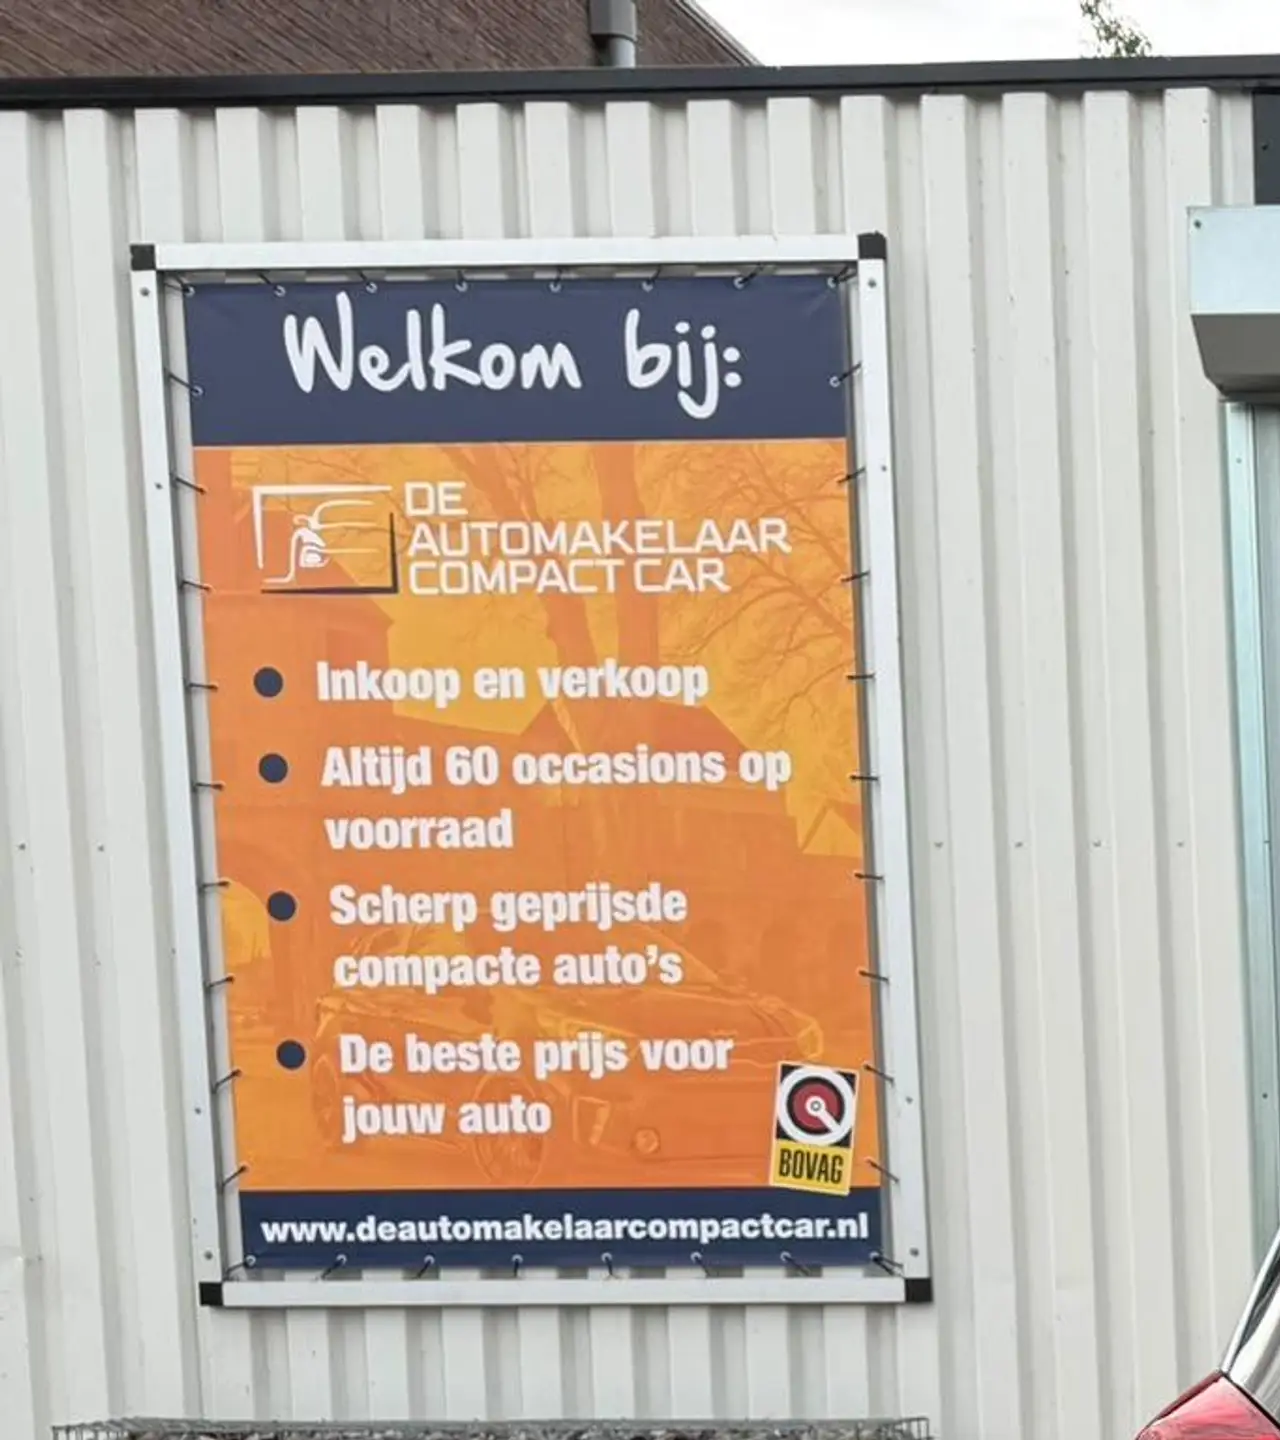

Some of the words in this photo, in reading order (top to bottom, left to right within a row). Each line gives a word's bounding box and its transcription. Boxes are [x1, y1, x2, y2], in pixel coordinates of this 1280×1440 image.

[283, 292, 582, 393] Welkom
[623, 309, 743, 418] bij:
[405, 481, 467, 517] DE
[408, 517, 792, 556] AUTOMAKELAAR
[410, 558, 625, 595] COMPACT
[634, 557, 732, 592] CAR
[316, 661, 460, 708] Inkoop
[474, 666, 525, 699] en
[538, 658, 709, 705] verkoop
[321, 746, 432, 794] Altijd
[445, 746, 499, 786] 60
[512, 744, 726, 785] occasions
[739, 750, 791, 790] op
[324, 808, 513, 849] voorraad
[330, 884, 477, 932] Scherp
[491, 882, 686, 930] geprijsde
[334, 947, 540, 994] compacte
[553, 945, 683, 984] auto's
[339, 1033, 392, 1073] De
[406, 1033, 520, 1073] beste
[534, 1033, 628, 1080] prijs
[640, 1037, 733, 1071] voor
[342, 1097, 445, 1142] jouw
[458, 1098, 551, 1134] auto
[779, 1148, 844, 1184] BOVAG
[261, 1213, 869, 1244] www.deautomakelaarcompactcar.nl
